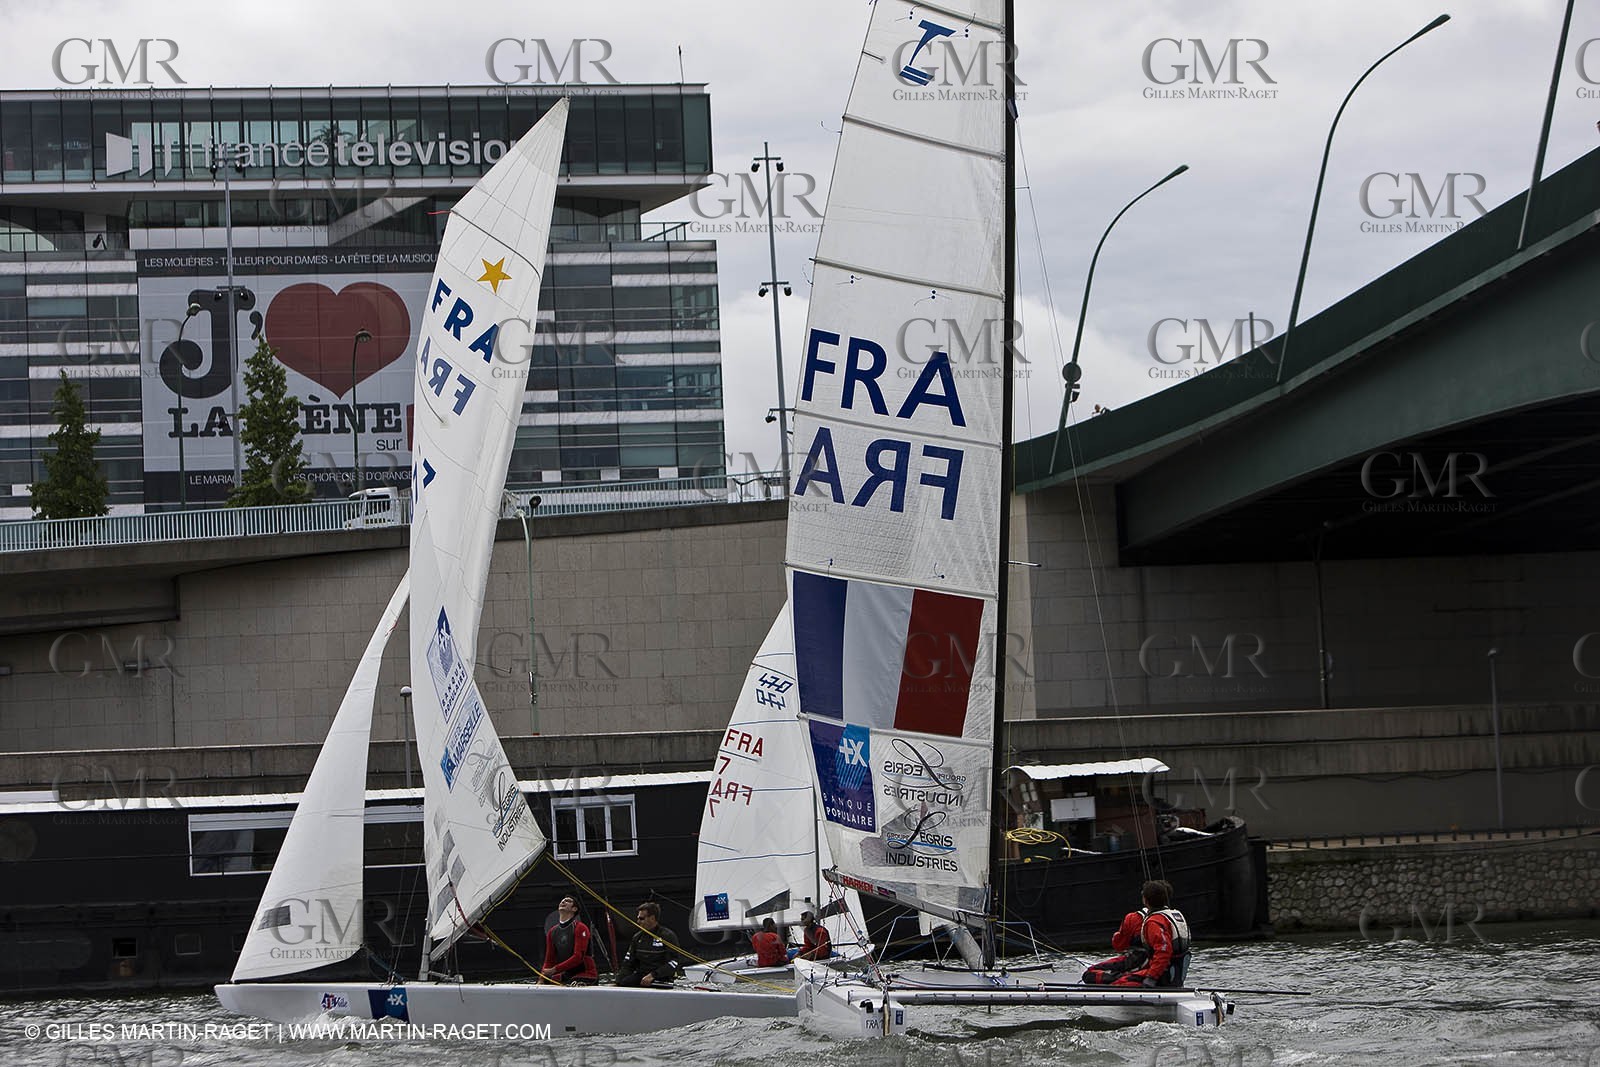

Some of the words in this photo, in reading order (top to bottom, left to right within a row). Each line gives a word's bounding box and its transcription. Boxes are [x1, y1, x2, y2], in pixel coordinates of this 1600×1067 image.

[144, 257, 163, 268] LES
[164, 255, 214, 268] MOLIÈRES
[265, 255, 293, 266] POUR
[294, 255, 328, 265] DAMES
[335, 255, 346, 265] LA
[347, 252, 371, 265] FÊTE
[371, 254, 386, 264] DE
[386, 254, 399, 264] LA
[399, 253, 437, 265] MUSIQU
[431, 278, 500, 364] FRA
[801, 328, 967, 427] FRA
[168, 407, 234, 438] LA
[297, 394, 402, 434] ÈNE
[376, 438, 403, 451] sur
[190, 475, 201, 485] LE
[203, 474, 238, 485] MARIA
[758, 673, 794, 694] 470
[724, 728, 764, 757] FRA
[718, 755, 731, 775] 7
[823, 792, 872, 812] BANQUE
[826, 806, 873, 826] POPULAIRE
[885, 851, 958, 873] INDUSTRIES
[842, 874, 875, 894] HARKEN
